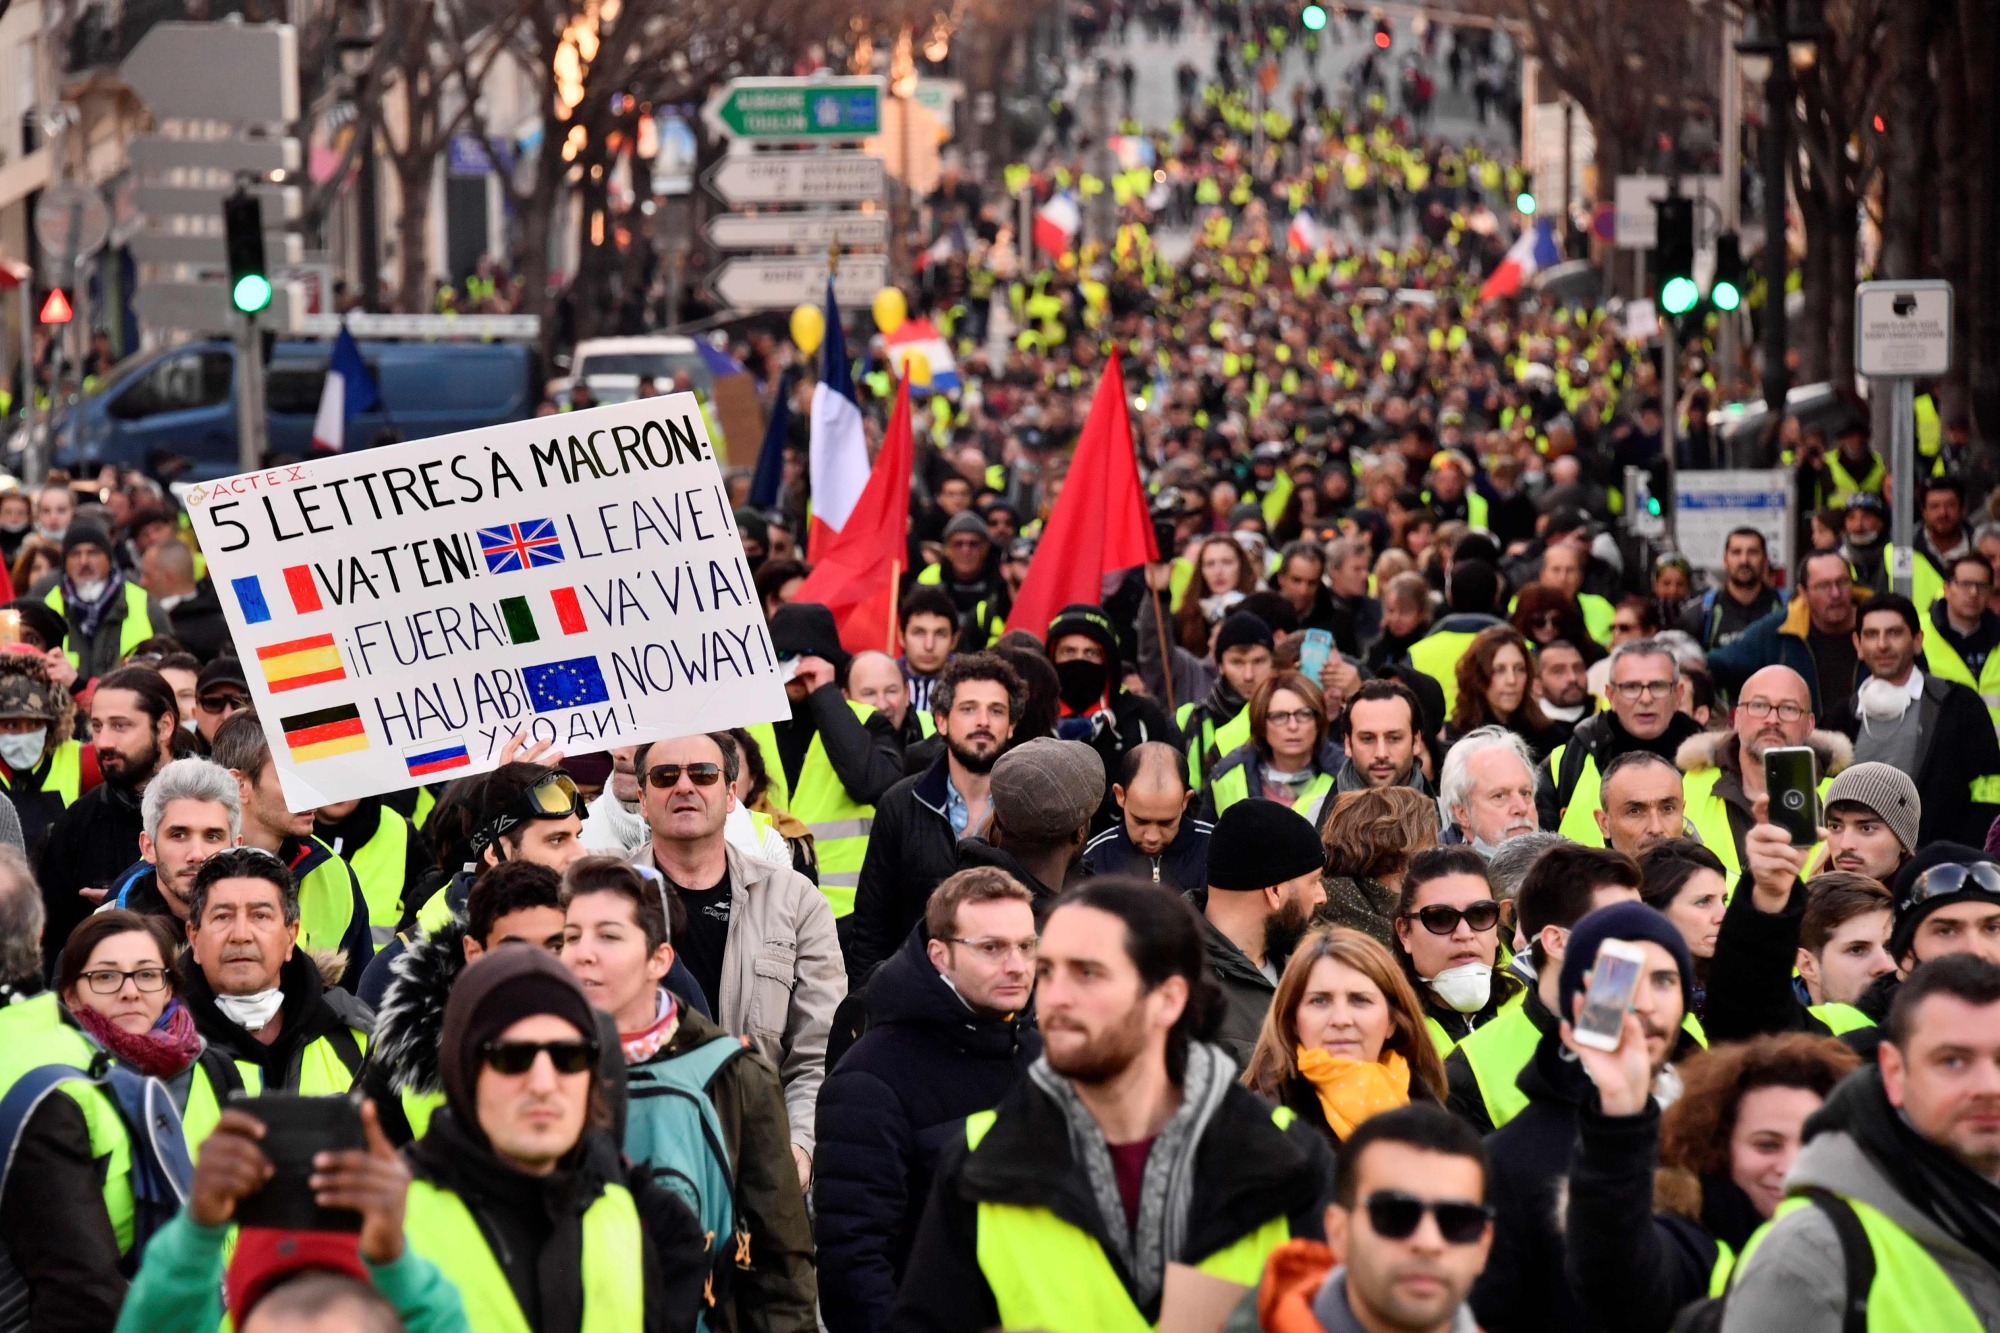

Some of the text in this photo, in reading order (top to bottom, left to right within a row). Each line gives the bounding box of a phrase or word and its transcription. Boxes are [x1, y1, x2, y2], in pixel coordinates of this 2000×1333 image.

[209, 414, 712, 552] 5 LETTRES À MACRON:
[212, 471, 281, 500] ACTE
[566, 485, 732, 559] LEAVE!
